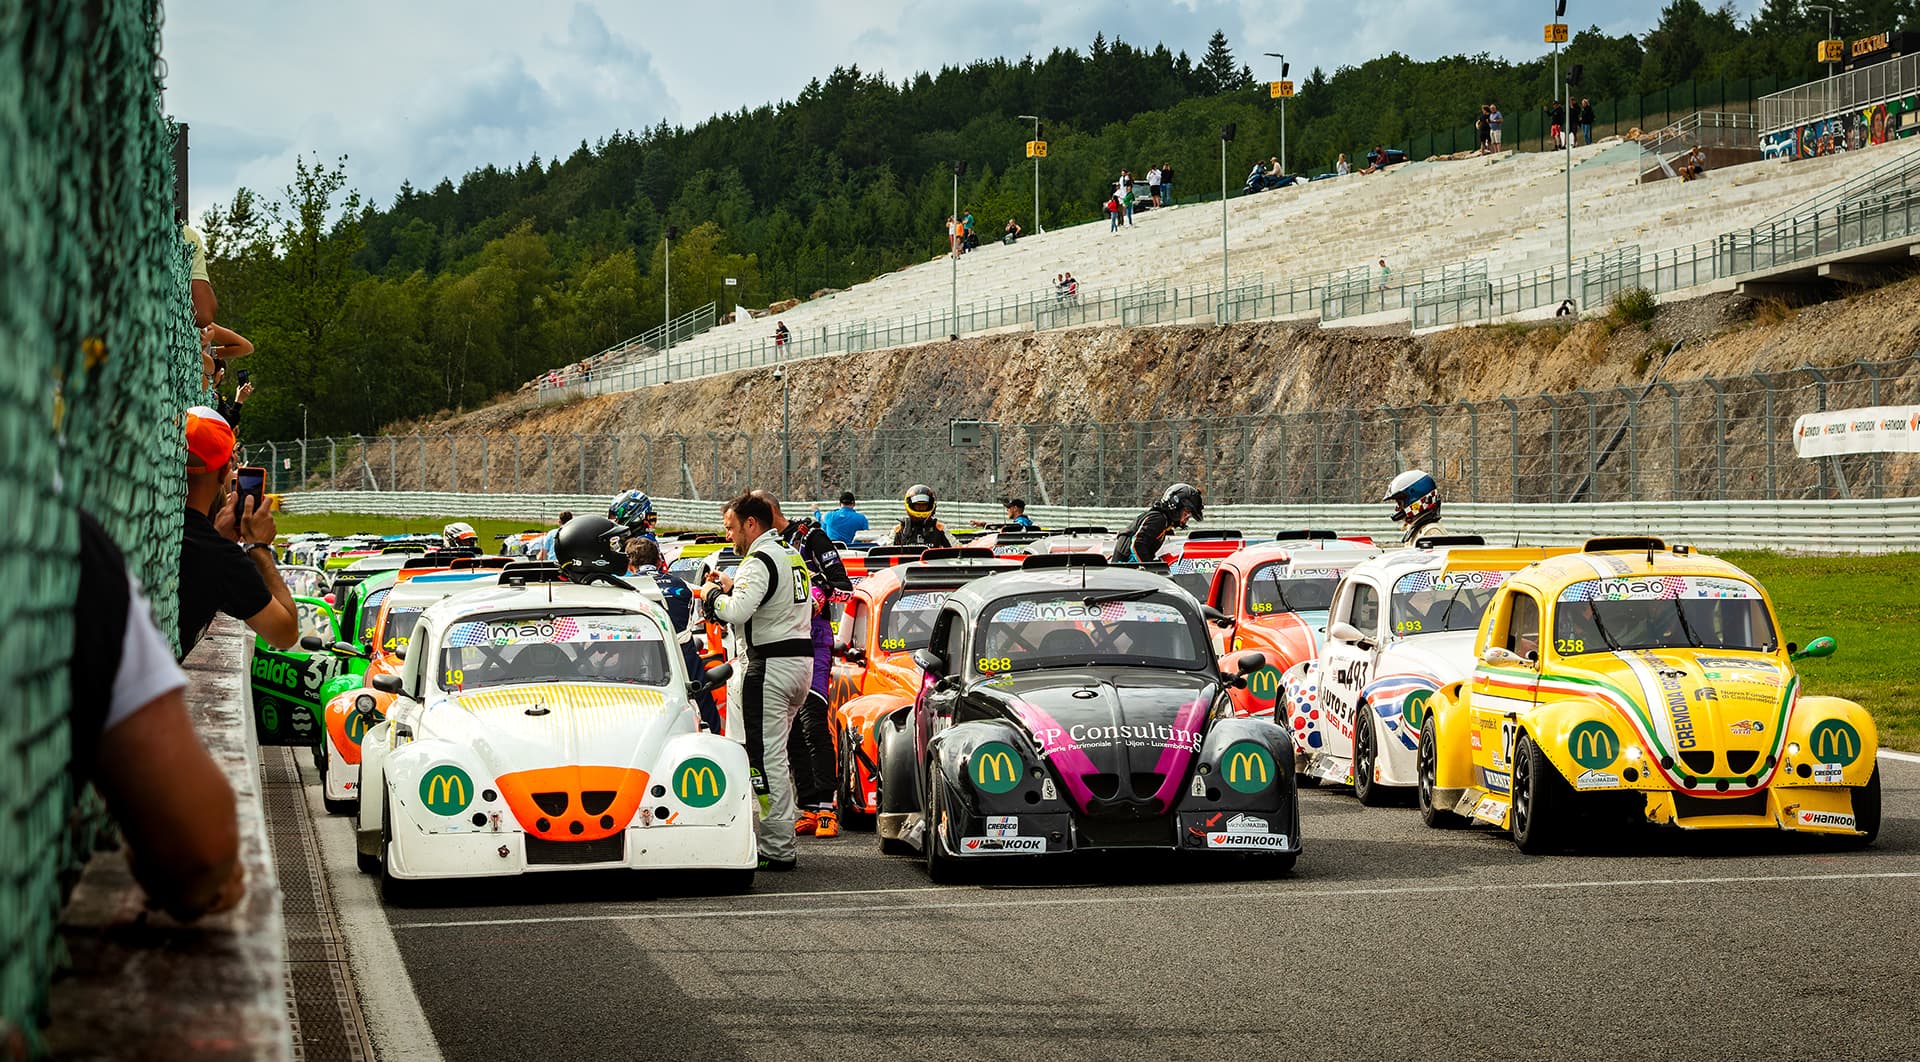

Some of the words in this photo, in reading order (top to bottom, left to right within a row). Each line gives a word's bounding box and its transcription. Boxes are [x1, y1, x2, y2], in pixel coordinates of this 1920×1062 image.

[1599, 581, 1664, 595] imao
[1035, 603, 1102, 618] imao
[1251, 602, 1273, 613] 458
[487, 624, 555, 639] imao
[1397, 620, 1422, 632] 493
[882, 638, 906, 650] 484
[1557, 639, 1584, 653] 258
[979, 657, 1011, 671] 888
[445, 669, 464, 685] 19
[1346, 660, 1369, 692] 493
[1667, 691, 1697, 749] CREMONA
[1033, 728, 1062, 753] SP
[1070, 722, 1203, 753] Consulting
